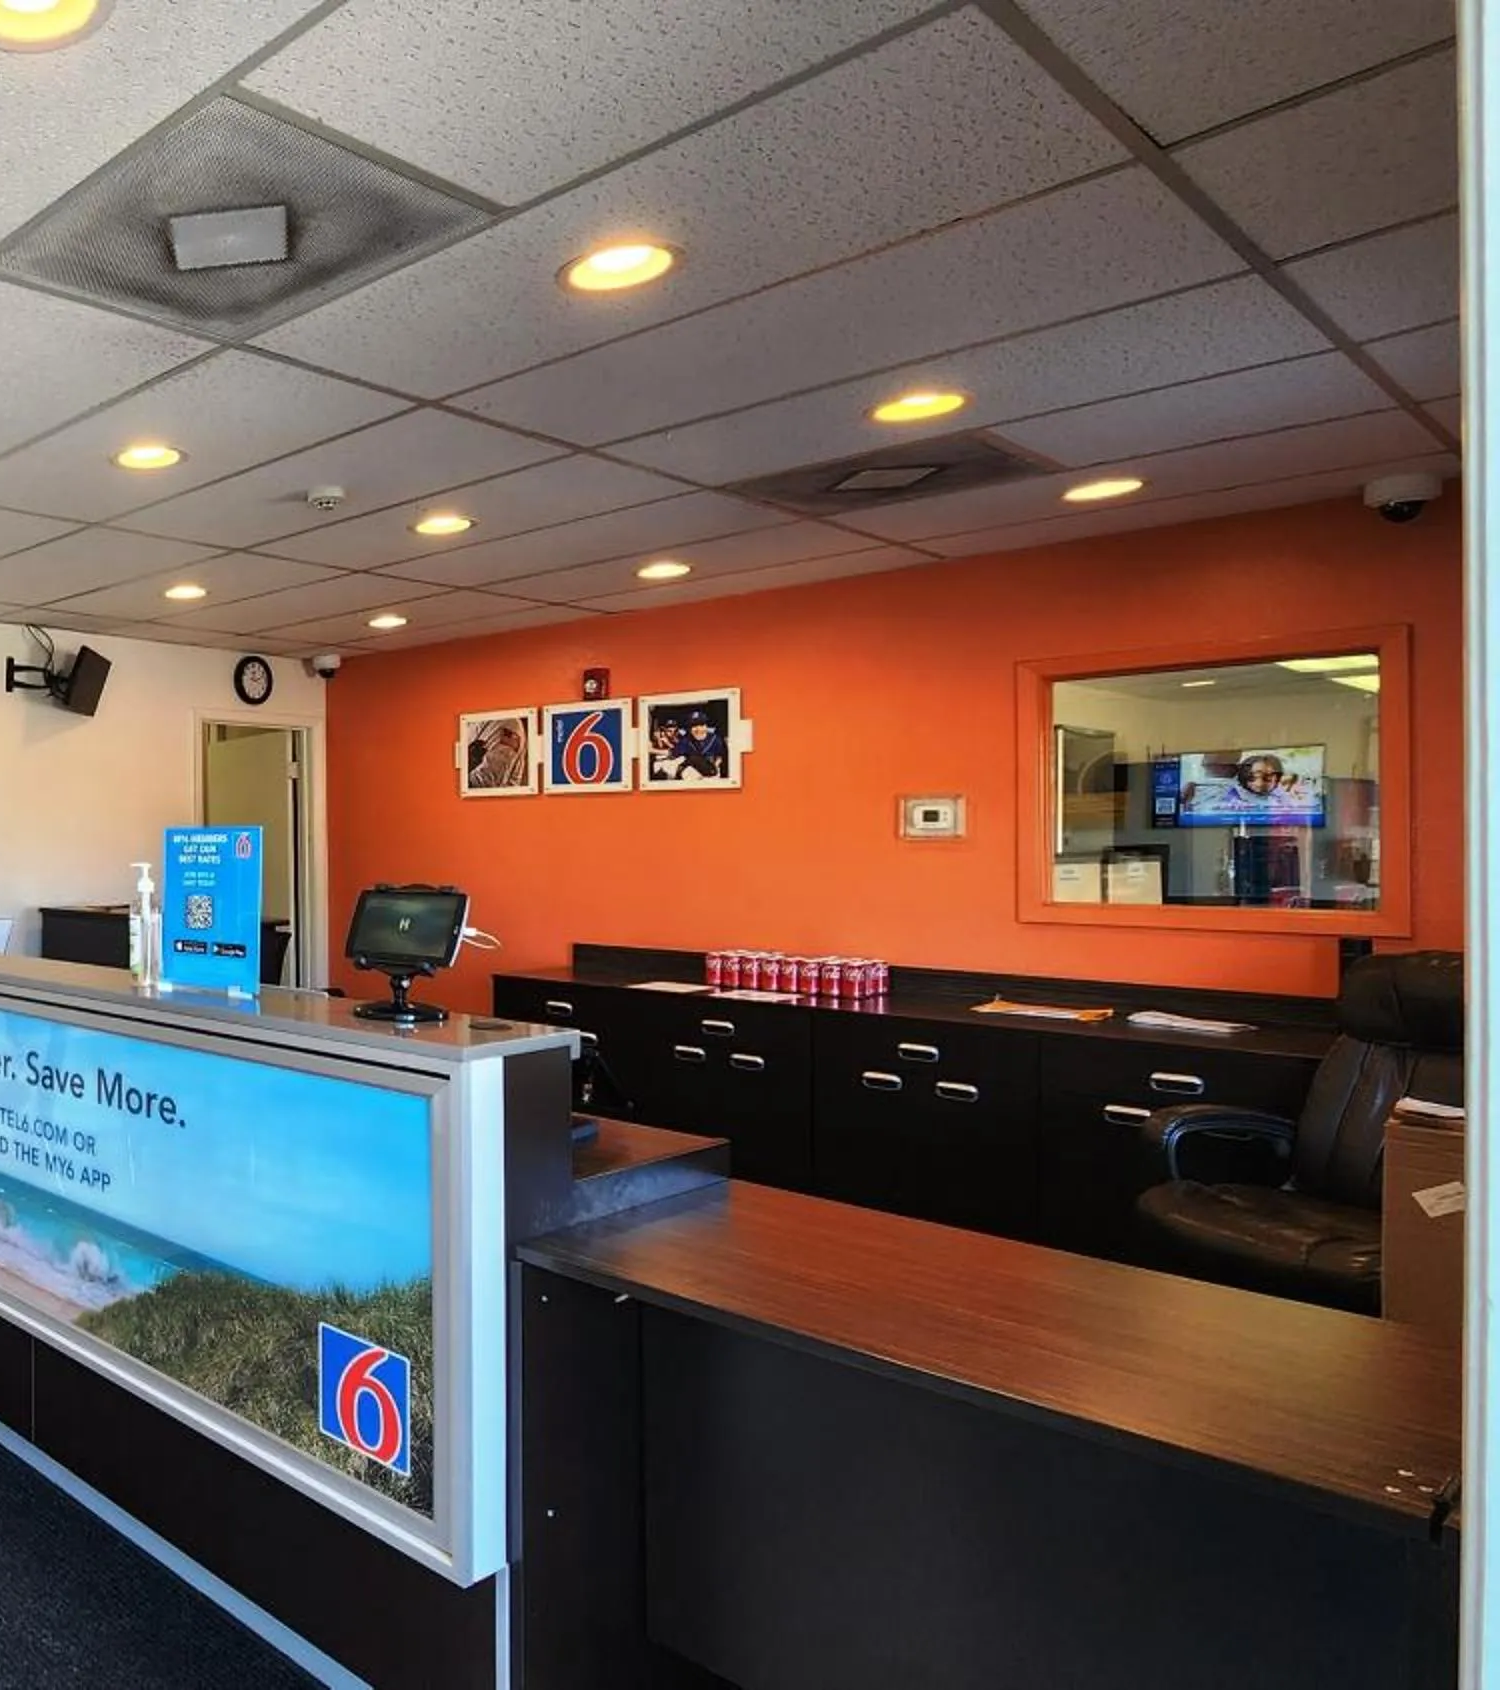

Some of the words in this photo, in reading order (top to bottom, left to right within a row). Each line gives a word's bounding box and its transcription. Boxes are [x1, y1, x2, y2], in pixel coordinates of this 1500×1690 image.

[563, 711, 614, 785] 6
[26, 1052, 85, 1099] Save
[97, 1068, 186, 1129] More.
[12, 1140, 39, 1168] THE
[45, 1152, 75, 1181] MY6
[80, 1166, 111, 1193] APP
[73, 1130, 97, 1155] OR
[336, 1346, 402, 1466] 6
